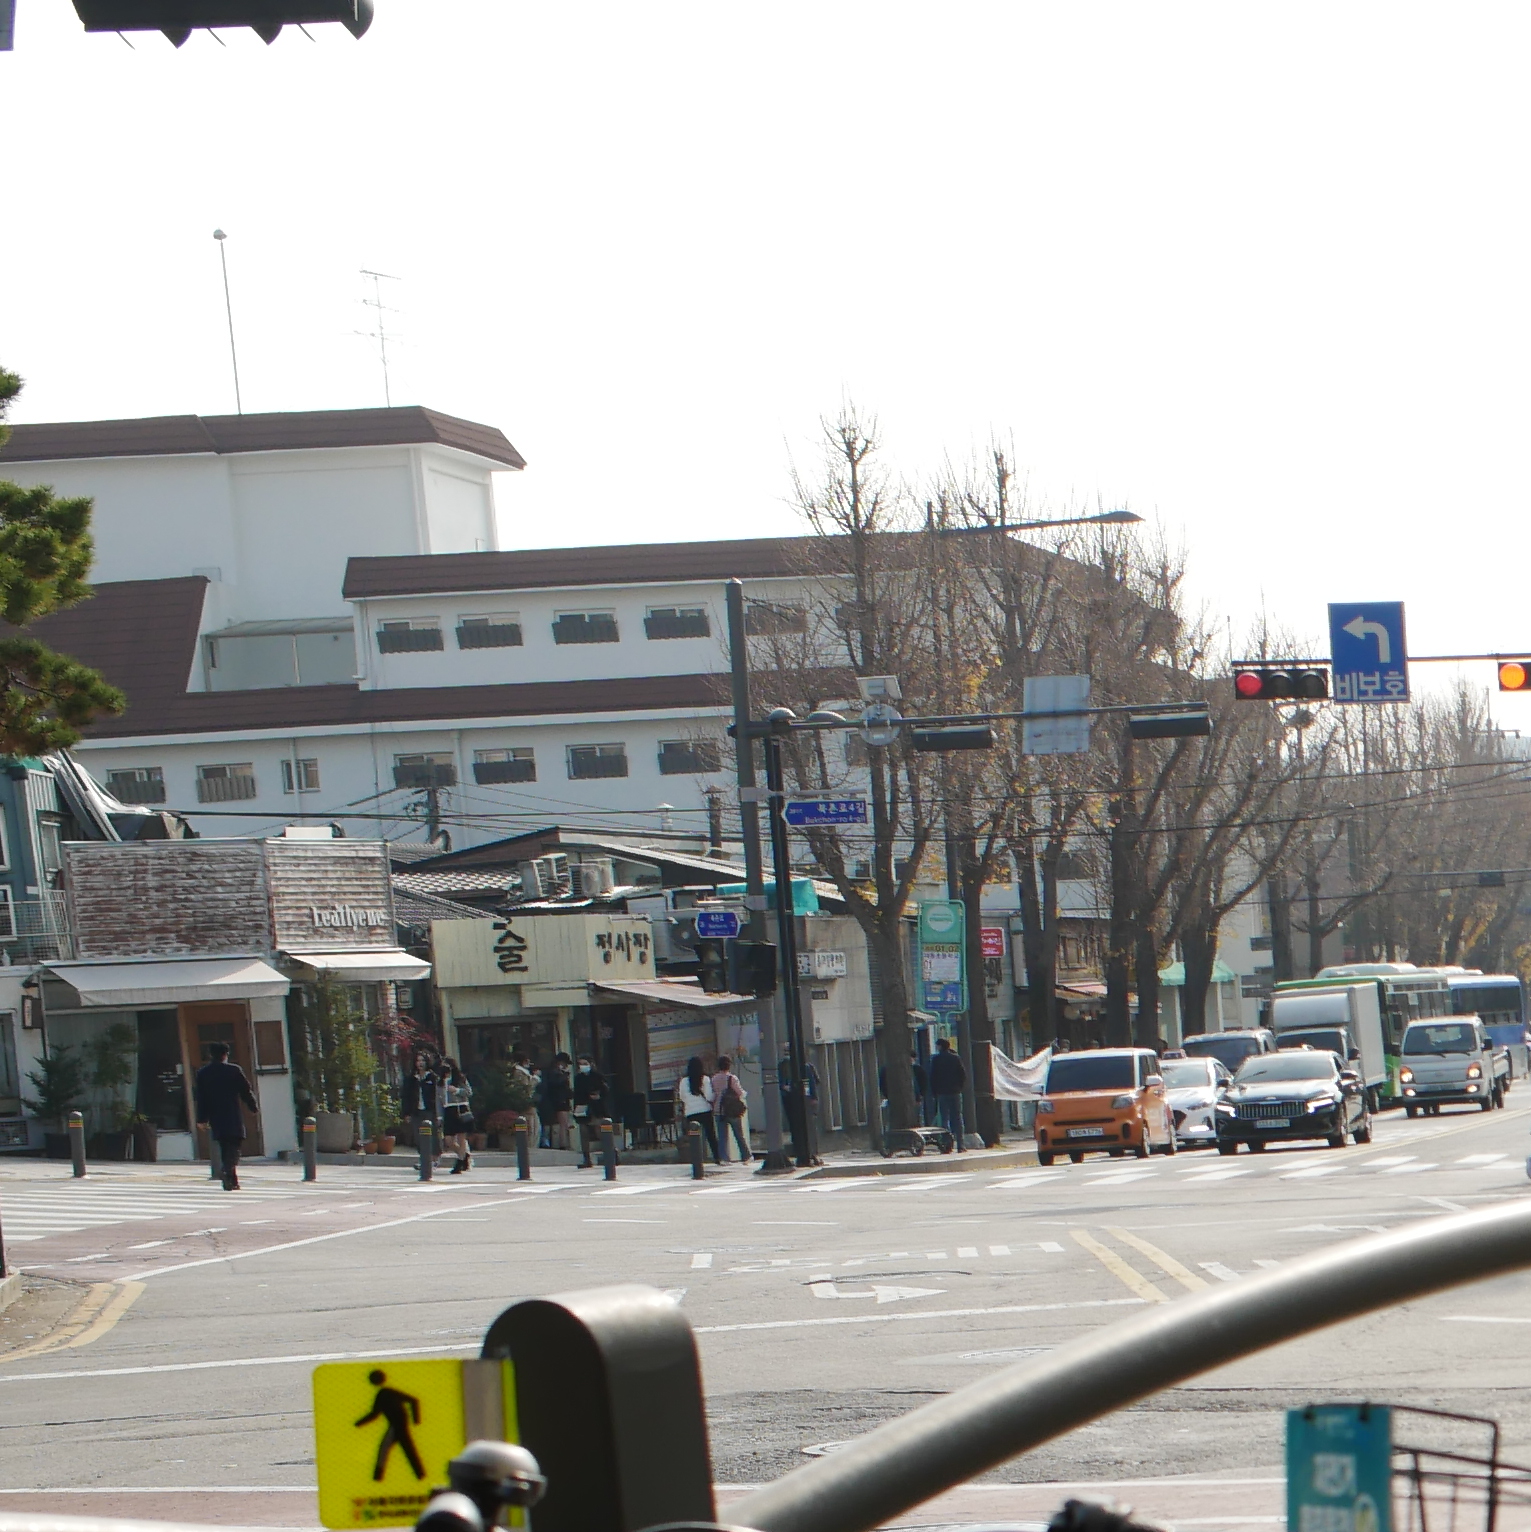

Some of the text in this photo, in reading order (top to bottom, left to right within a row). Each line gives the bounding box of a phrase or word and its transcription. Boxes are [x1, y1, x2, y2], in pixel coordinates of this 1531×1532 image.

[1335, 671, 1407, 701] 비보호
[817, 802, 865, 814] 북촌로4길
[596, 931, 650, 965] 정사장
